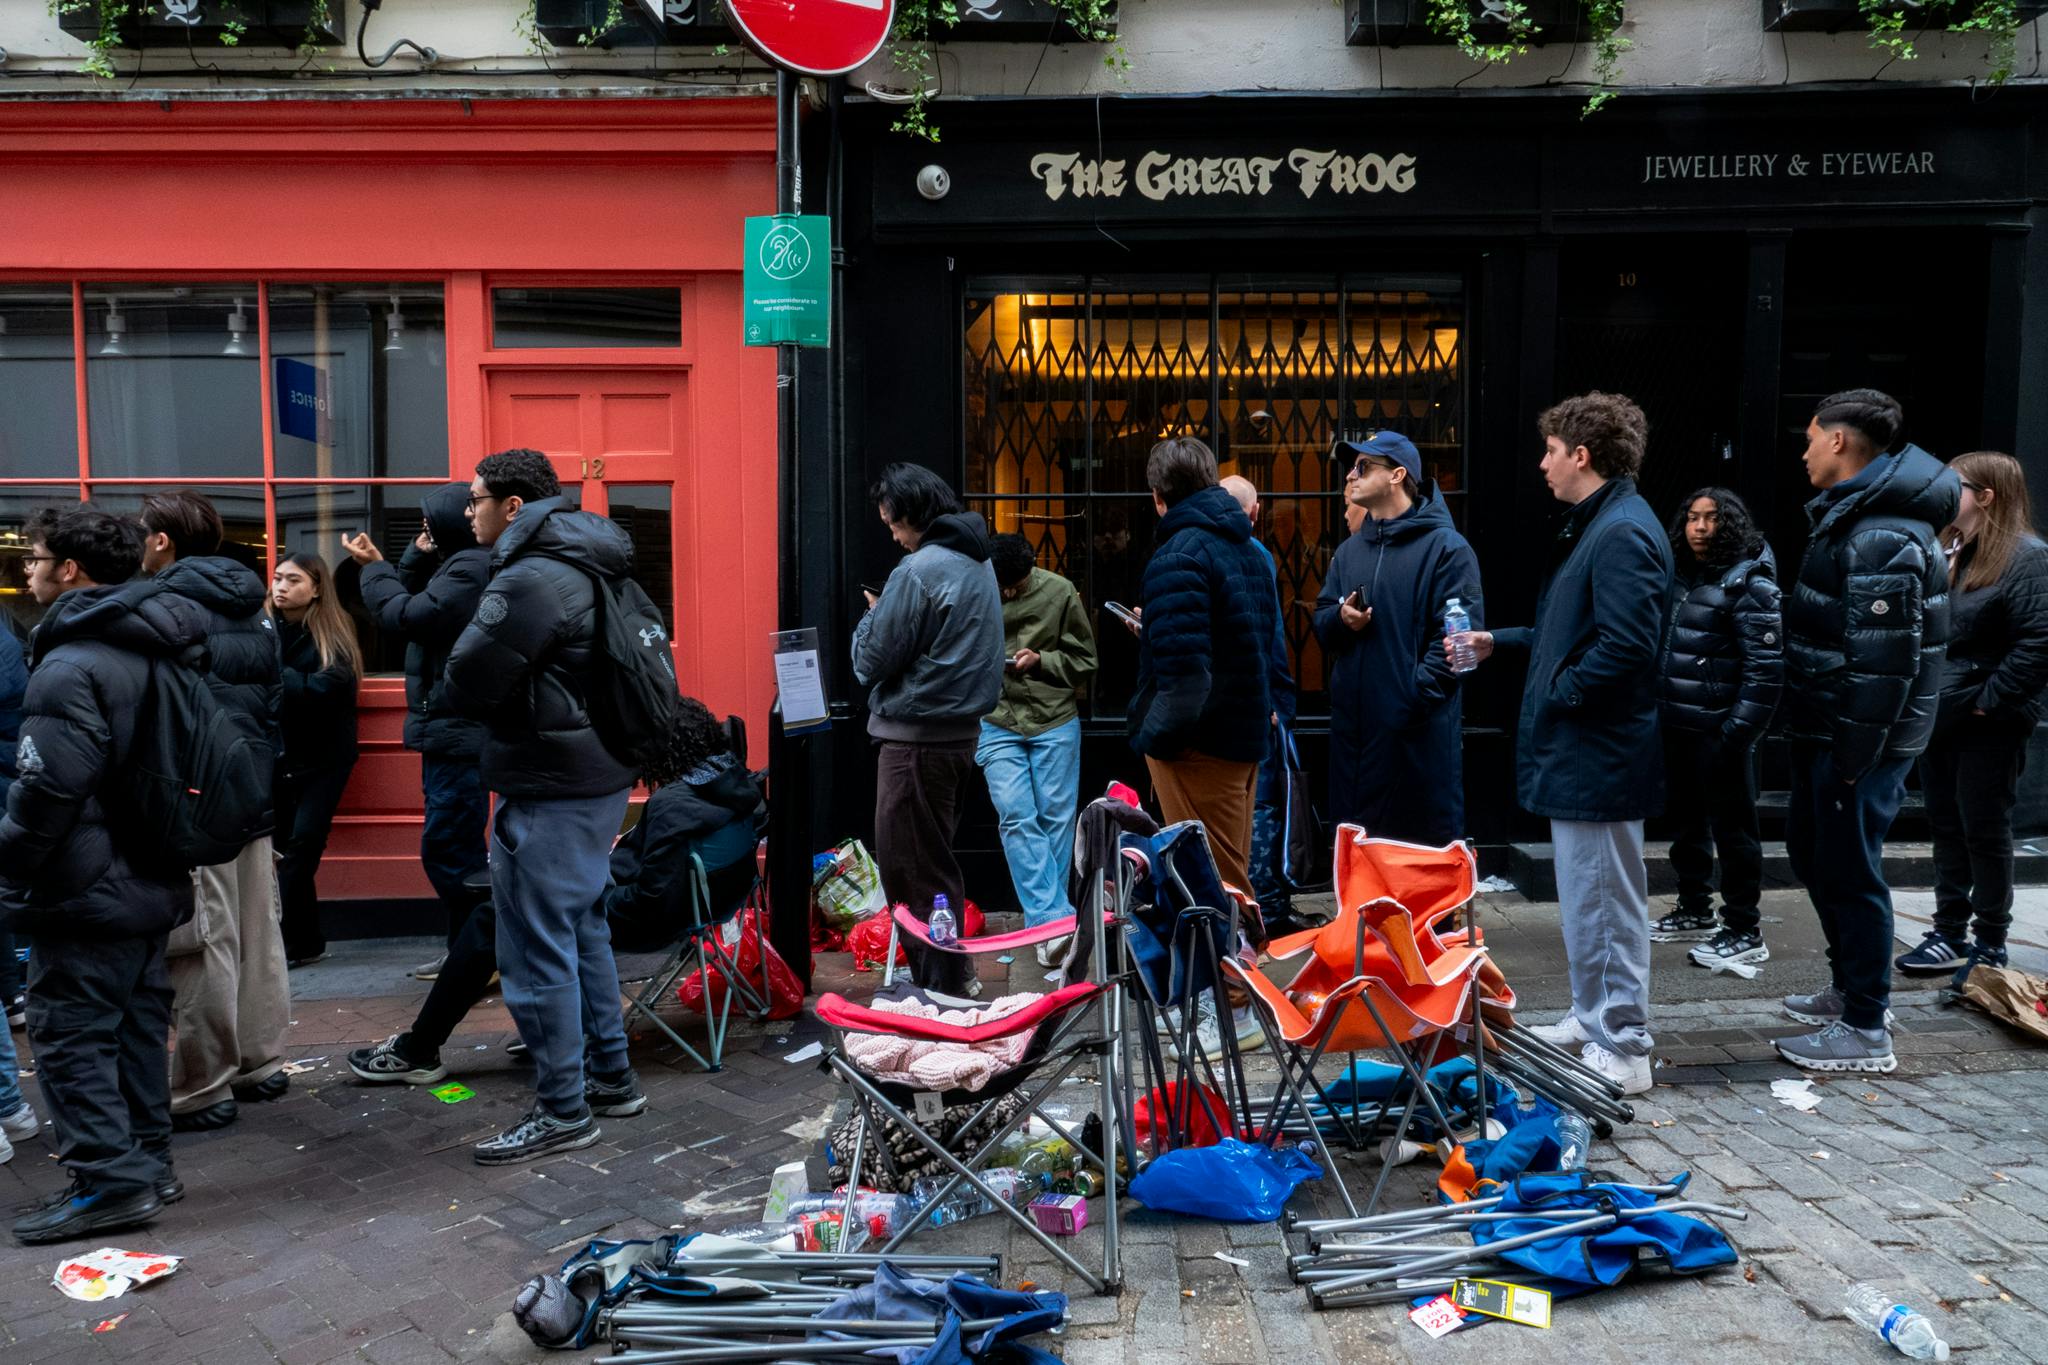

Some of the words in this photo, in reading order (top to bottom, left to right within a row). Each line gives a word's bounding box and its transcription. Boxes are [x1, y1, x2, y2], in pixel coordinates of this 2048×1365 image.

[1642, 154, 1778, 183] JEWELLERY
[1787, 154, 1810, 176] &
[1822, 151, 1935, 175] EYEWEAR
[1619, 272, 1636, 287] 10
[580, 458, 605, 480] 12
